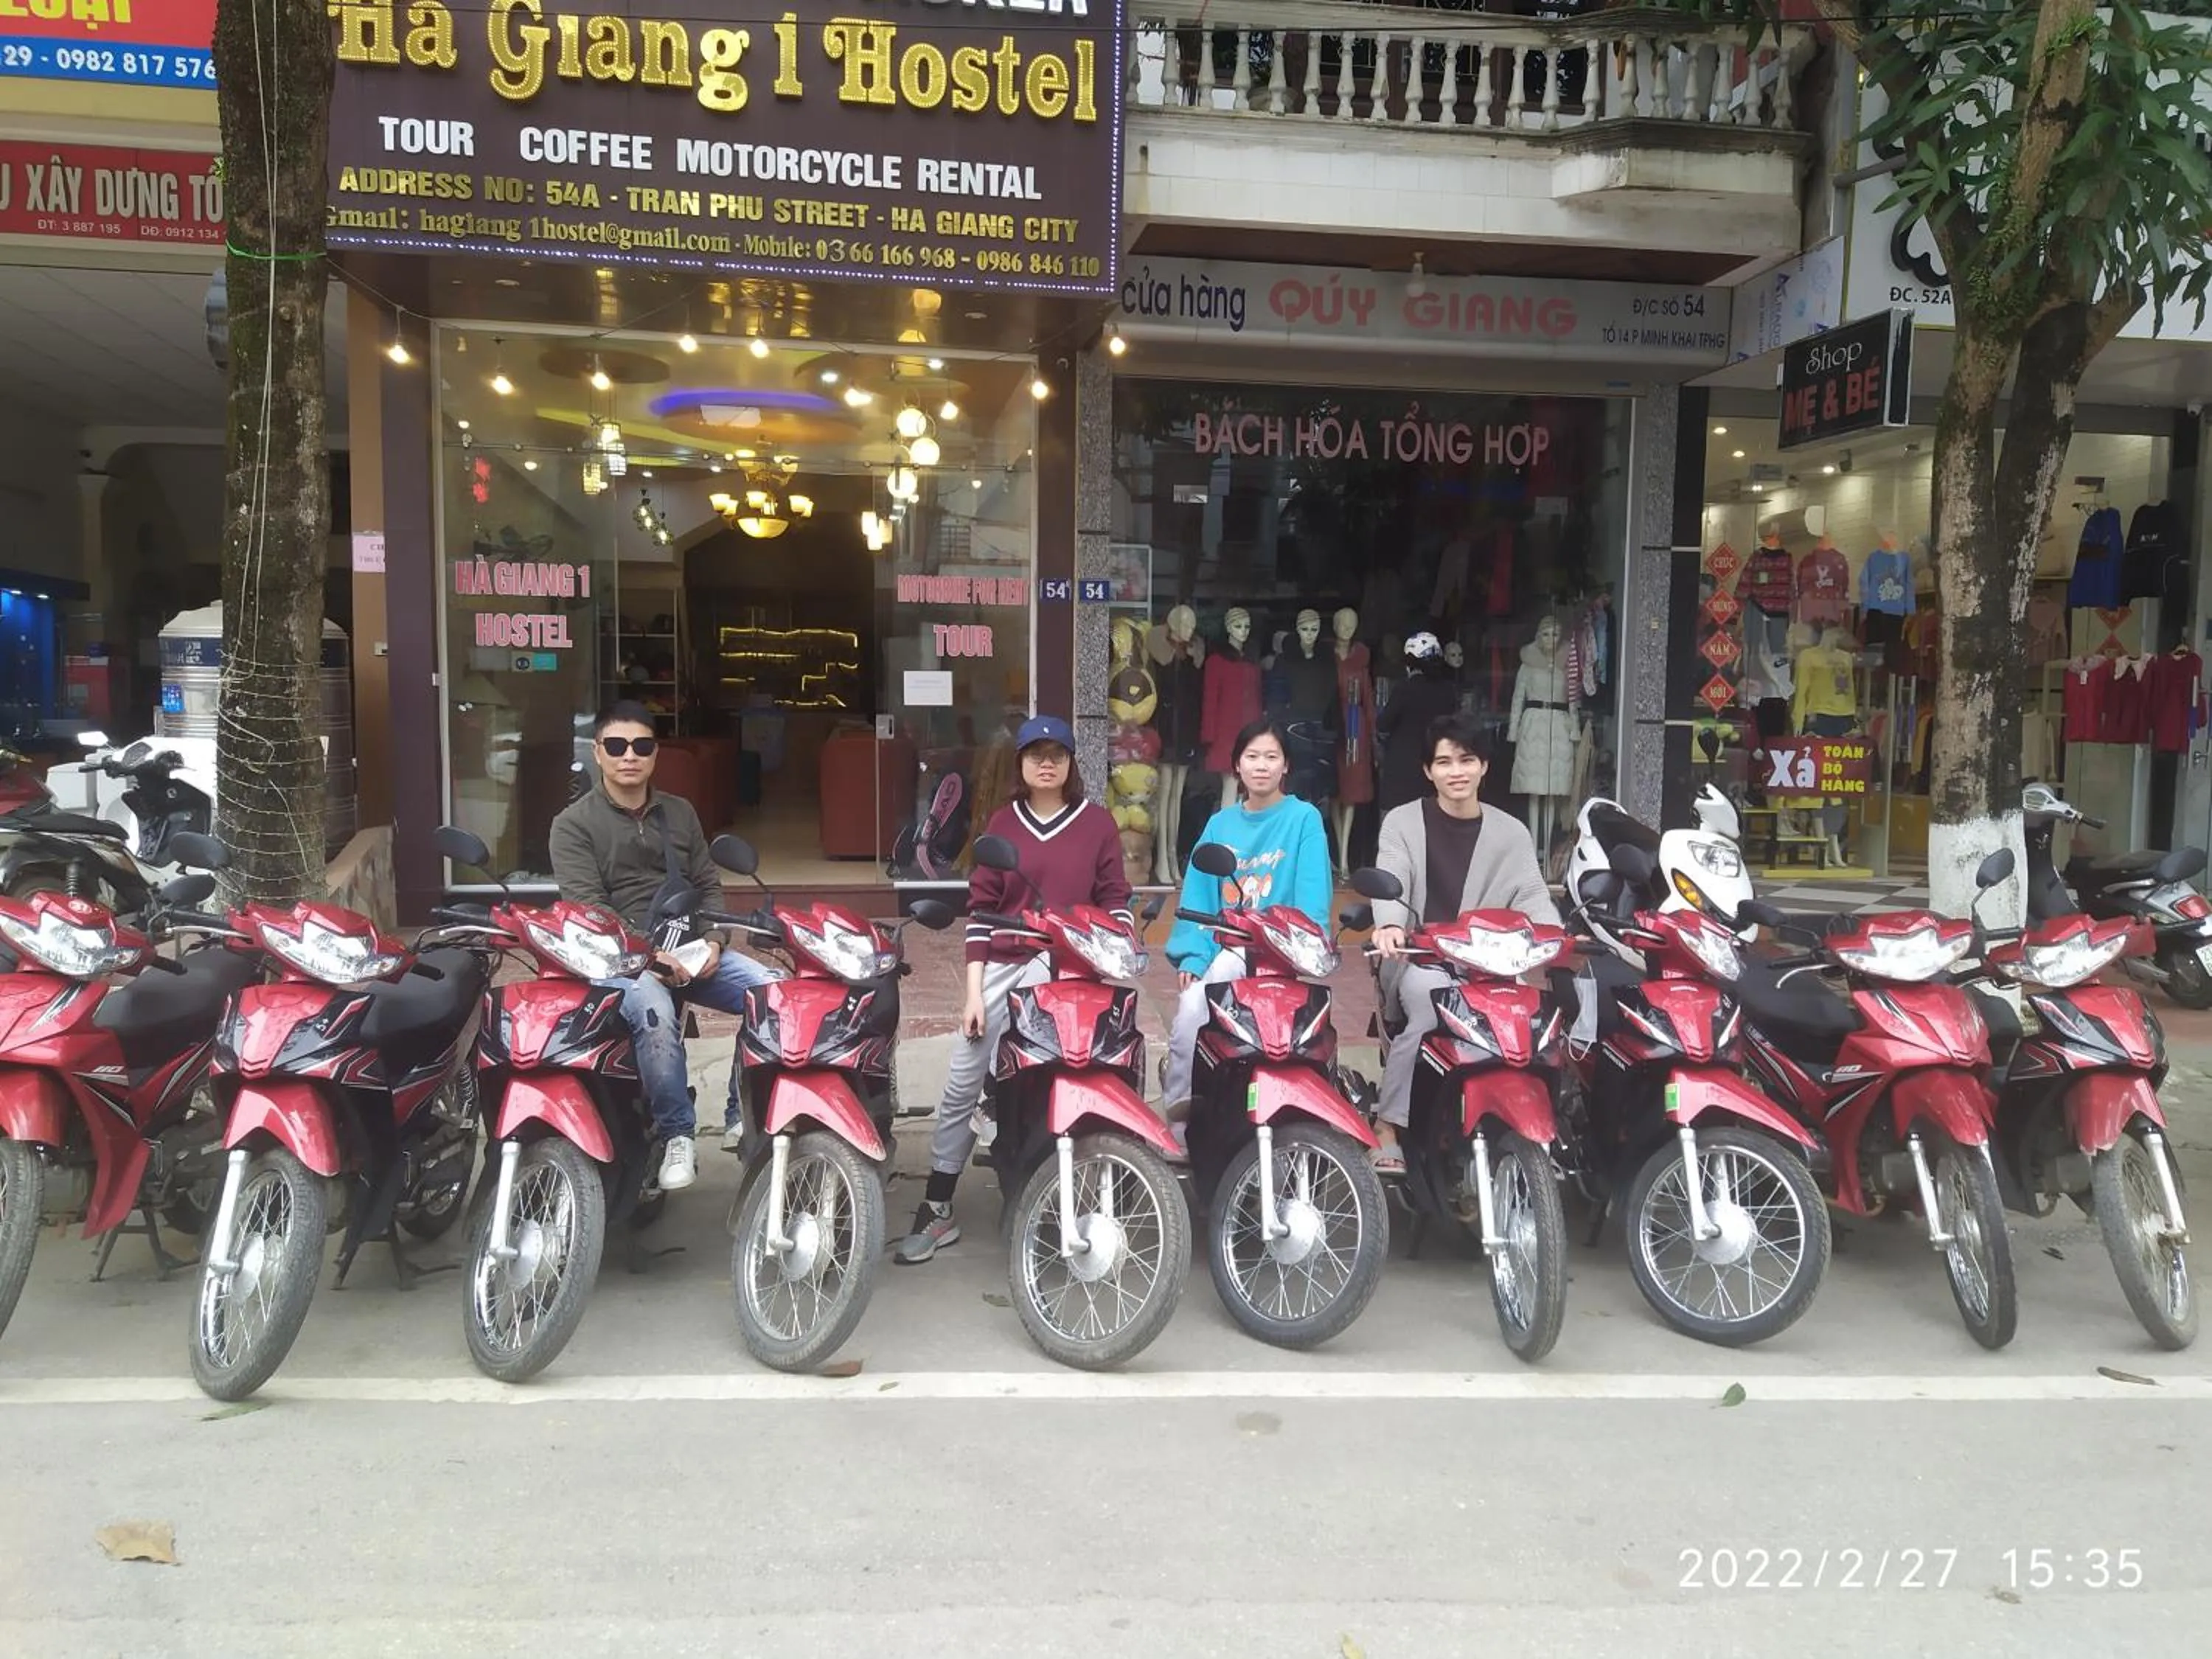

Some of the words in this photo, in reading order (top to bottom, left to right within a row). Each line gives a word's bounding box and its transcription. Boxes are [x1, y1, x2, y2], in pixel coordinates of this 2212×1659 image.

[0, 45, 32, 66] 29
[56, 48, 115, 72] 0982
[123, 52, 164, 74] 817
[175, 57, 217, 79] 576
[487, 0, 751, 111] Giang
[822, 17, 1097, 122] Hostel
[378, 116, 474, 156] TOUR
[520, 126, 653, 170] COFFEE
[676, 138, 902, 189] MOTORCYCLE
[917, 158, 1042, 200] RENTAL
[25, 154, 82, 215] XÂY
[339, 166, 473, 199] ADDRESS
[484, 175, 535, 203] NO:
[546, 181, 600, 208] 54A
[627, 187, 700, 216] TRAN
[709, 193, 763, 220] PHU
[774, 198, 869, 228] STREET
[891, 207, 927, 232] HA
[936, 210, 1014, 240] GIANG
[1024, 217, 1079, 243] CITY
[73, 221, 94, 232] 887
[166, 227, 193, 238] 0912
[420, 208, 522, 242] hagiang
[743, 234, 811, 258] Mobile:
[881, 244, 914, 266] 166
[919, 246, 956, 269] 968
[976, 250, 1023, 273] 0986
[1029, 252, 1064, 276] 846
[1070, 257, 1100, 277] 110
[1121, 266, 1171, 316] cửa
[1180, 274, 1245, 332] hàng
[1403, 291, 1578, 338] GIANG
[1683, 294, 1705, 316] 54
[1806, 342, 1863, 375] Shop
[1823, 378, 1839, 421] &
[1846, 356, 1879, 415] BÉ
[1194, 402, 1283, 456] BÁCH
[1295, 406, 1368, 459] HÓA
[1380, 401, 1473, 465] TỔNG
[1484, 422, 1548, 474] HỢP
[455, 554, 493, 595] HÀ
[493, 561, 574, 598] GIANG
[577, 565, 590, 598] 1
[1086, 582, 1104, 599] 54
[475, 613, 573, 648] HOSTEL
[933, 625, 993, 658] TOUR
[1767, 745, 1816, 788] Xả
